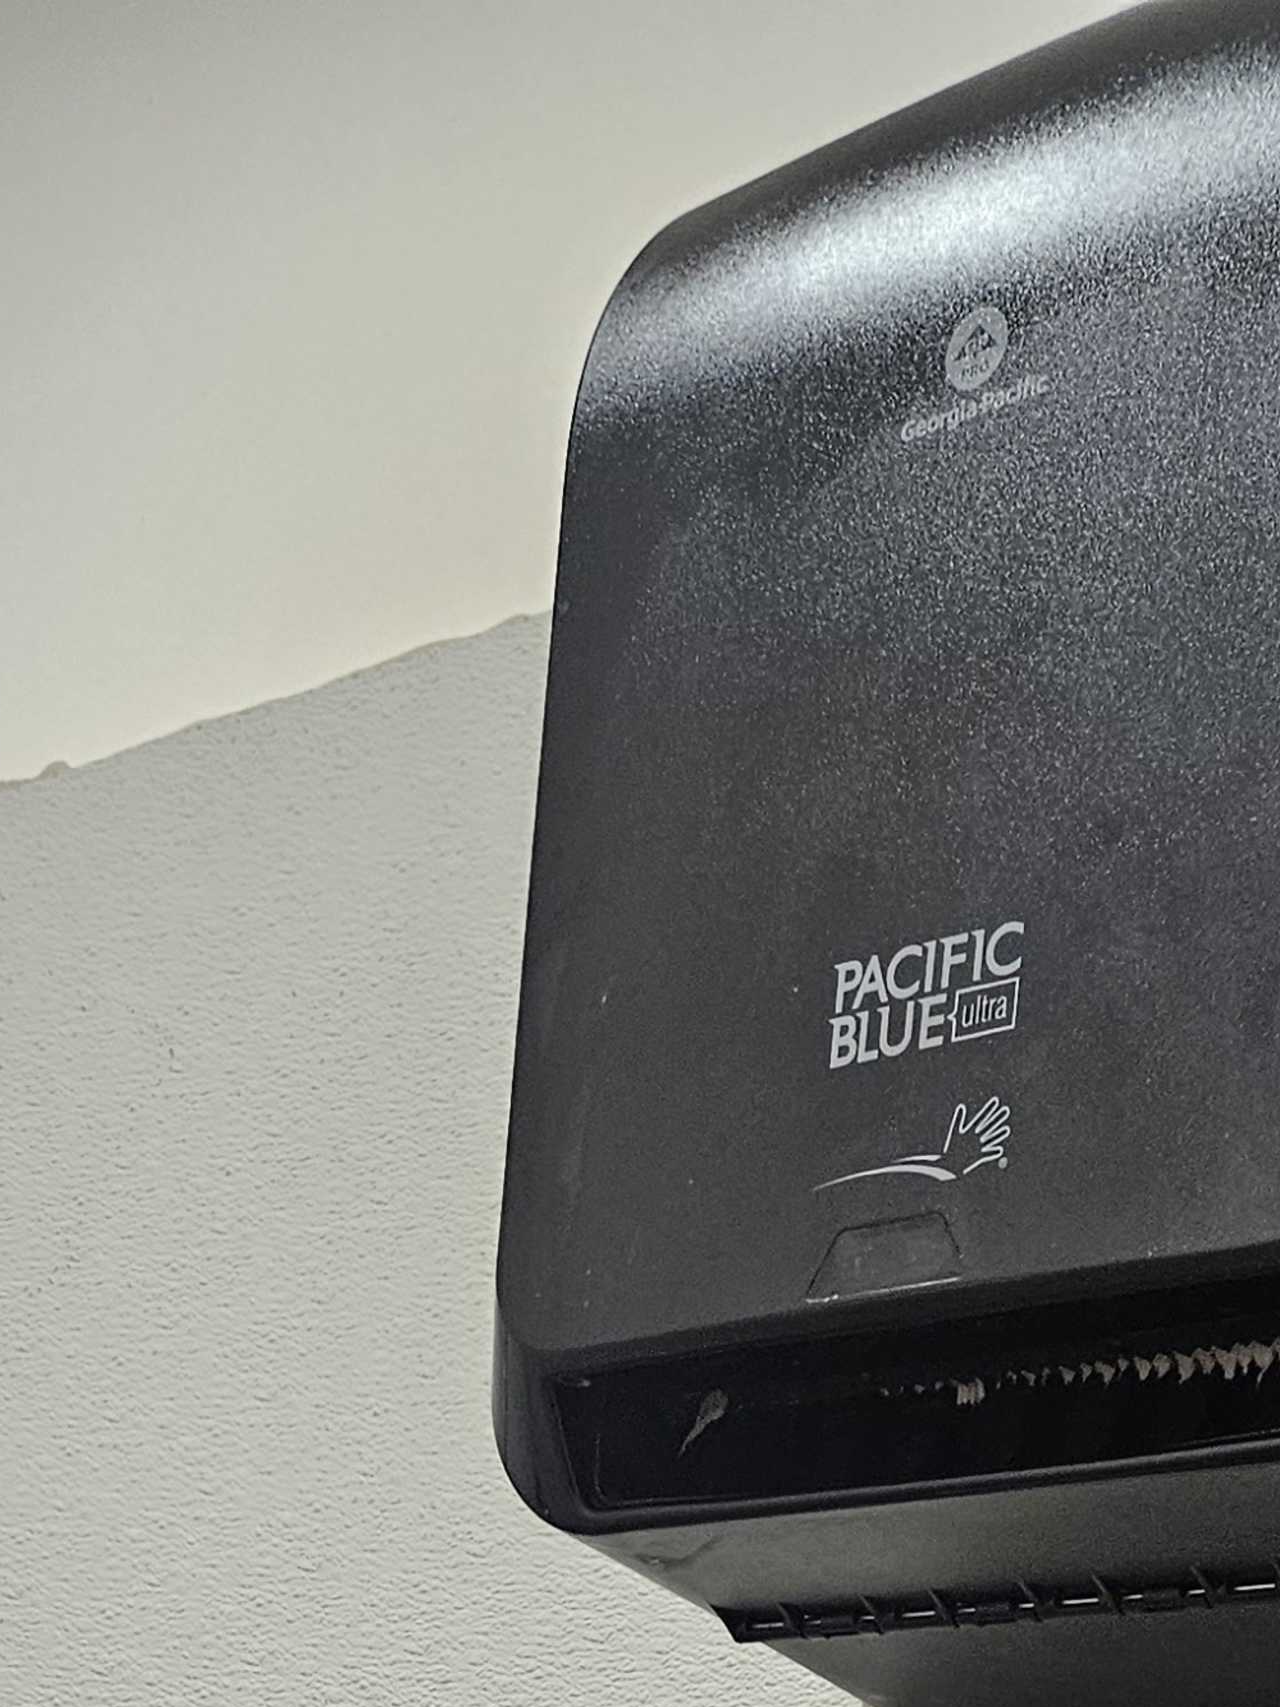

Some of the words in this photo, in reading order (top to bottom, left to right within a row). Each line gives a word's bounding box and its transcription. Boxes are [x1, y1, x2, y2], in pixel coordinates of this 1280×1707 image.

[834, 920, 1025, 1015] PACIFIC
[828, 992, 948, 1069] BLUE
[961, 994, 1008, 1028] ultra
